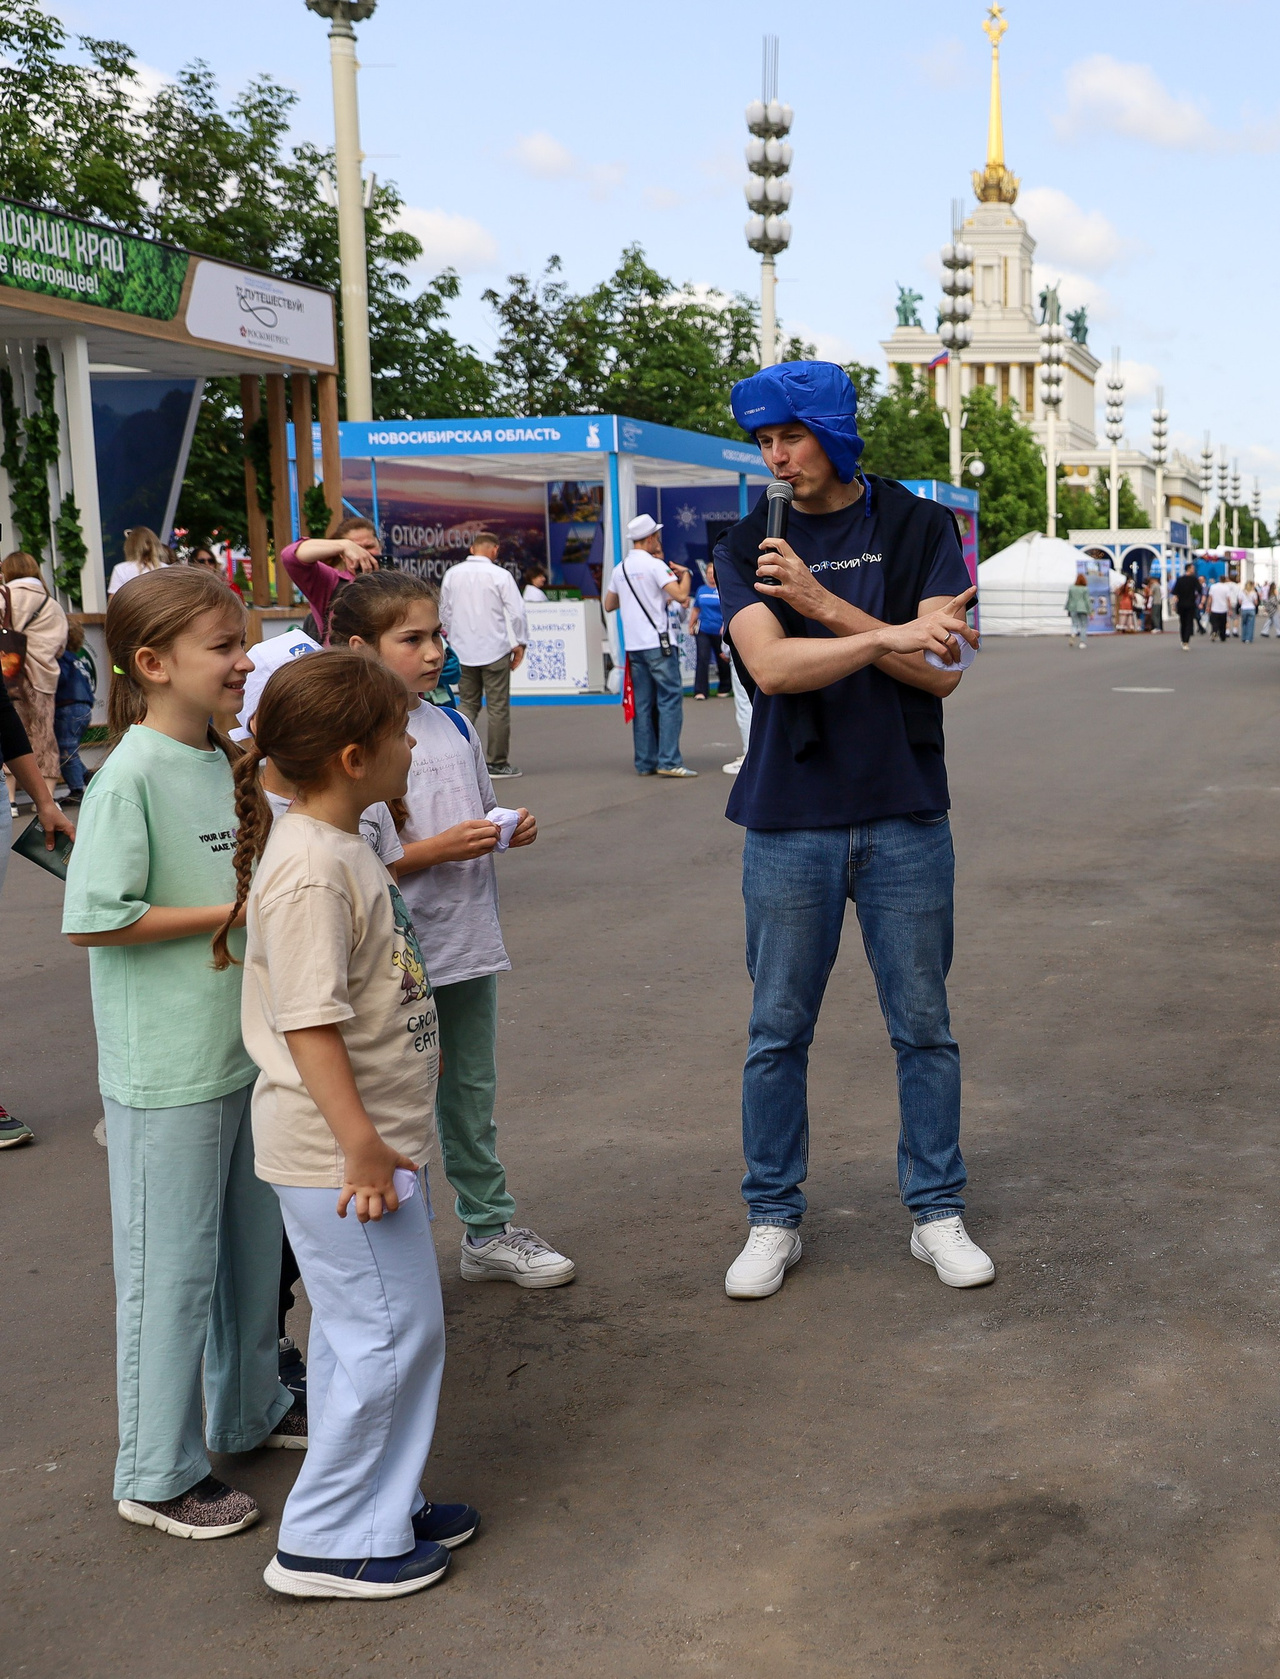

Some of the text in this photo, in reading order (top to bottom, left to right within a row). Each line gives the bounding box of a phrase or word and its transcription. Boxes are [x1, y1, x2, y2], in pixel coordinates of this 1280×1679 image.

[0, 204, 125, 274] ЙСКИЙ КРАЙ
[12, 257, 100, 295] настоящее!
[368, 428, 561, 445] НОВОСИБИРСКАЯ ОБЛАСТЬ
[391, 523, 445, 548] ОТКРОЙ
[199, 833, 218, 843] YOUR
[218, 831, 232, 840] LIFE
[211, 843, 230, 852] MAKE
[414, 1030, 437, 1053] EAT
